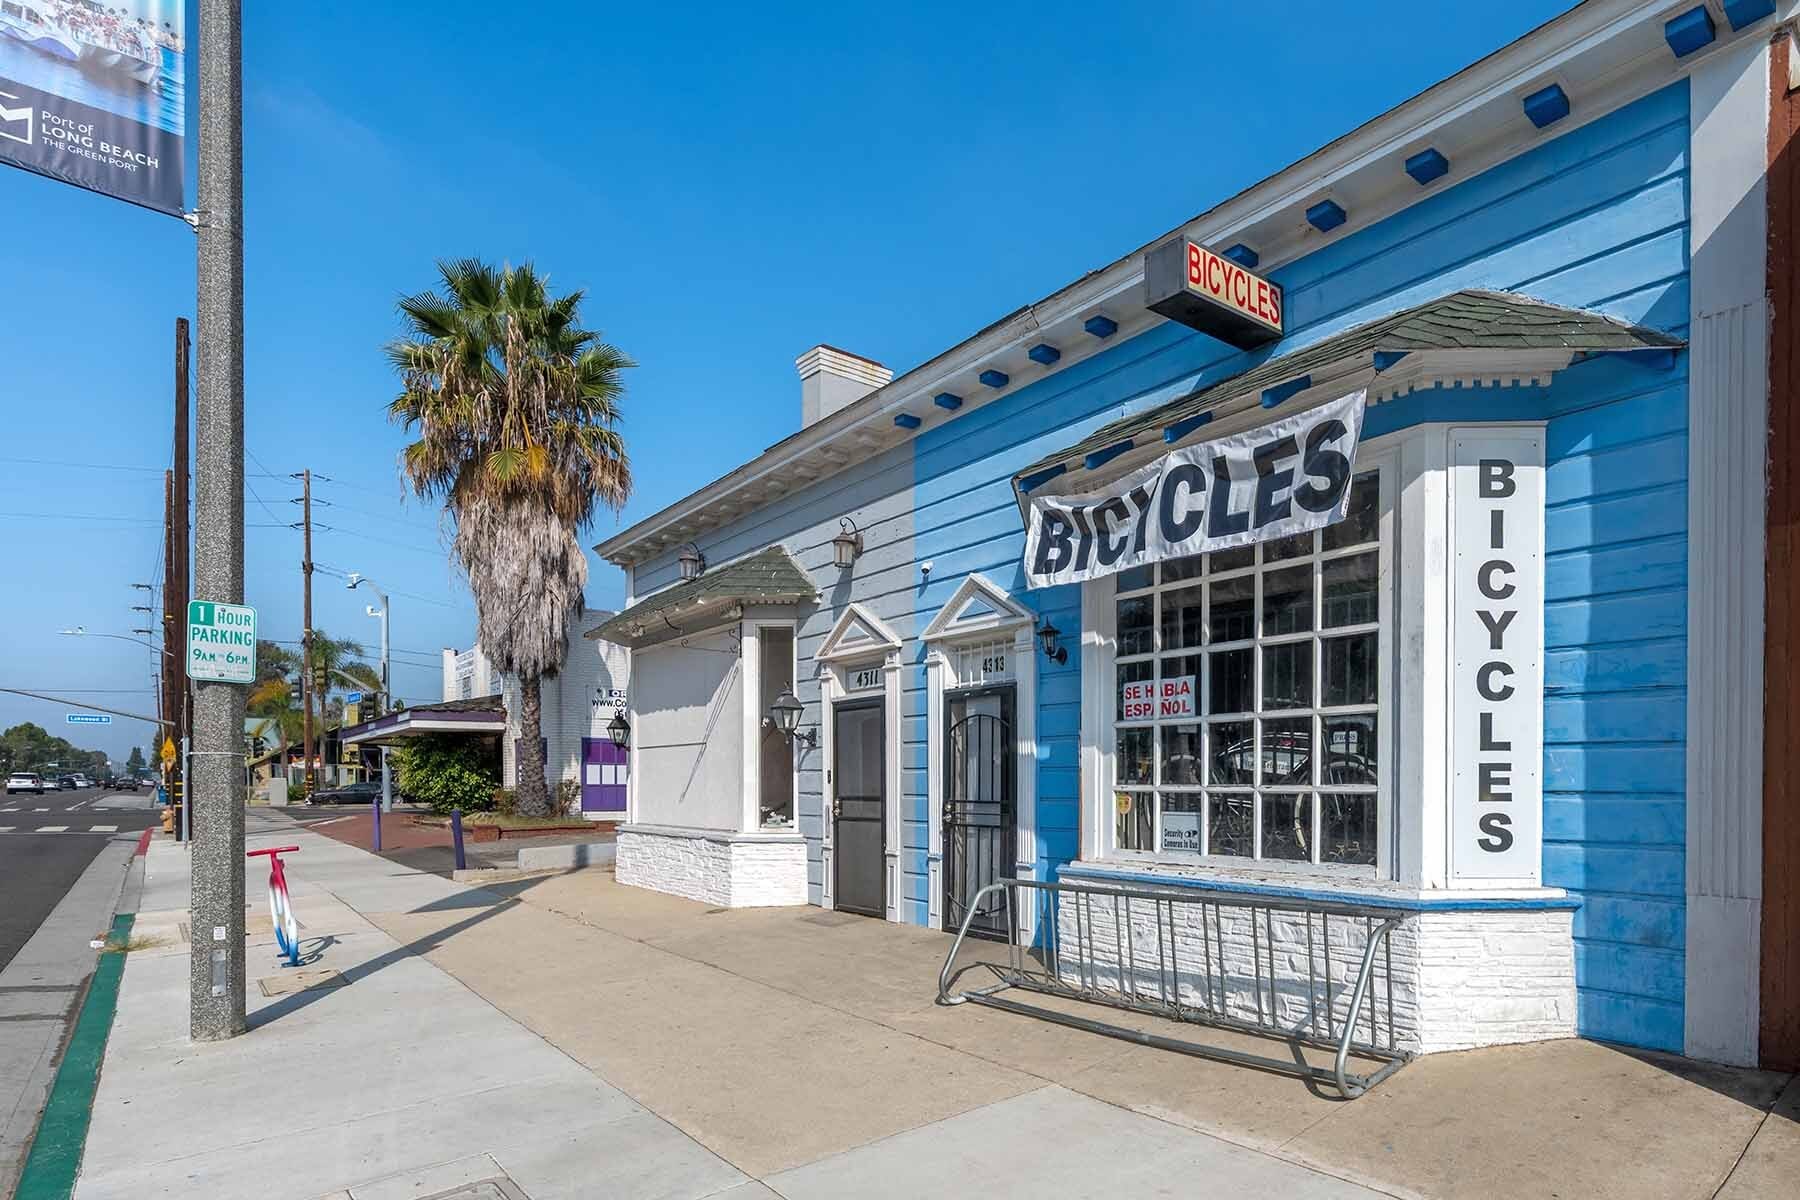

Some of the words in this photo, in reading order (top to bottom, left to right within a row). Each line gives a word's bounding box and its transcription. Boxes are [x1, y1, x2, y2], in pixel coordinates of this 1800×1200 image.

[78, 124, 95, 136] of
[41, 123, 93, 148] LONG
[100, 142, 159, 169] BEACH
[42, 136, 65, 151] THE
[67, 144, 106, 163] GREEN
[108, 157, 138, 172] PORT
[1187, 242, 1281, 325] BICYCLES
[1032, 419, 1350, 576] BICYCLES
[198, 605, 205, 622] 1
[218, 611, 251, 626] HOUR
[192, 627, 252, 646] PARKING
[1476, 459, 1518, 852] BICYCLES
[856, 670, 878, 686] 4311
[1125, 686, 1141, 700] SE
[1145, 680, 1190, 698] HBLA
